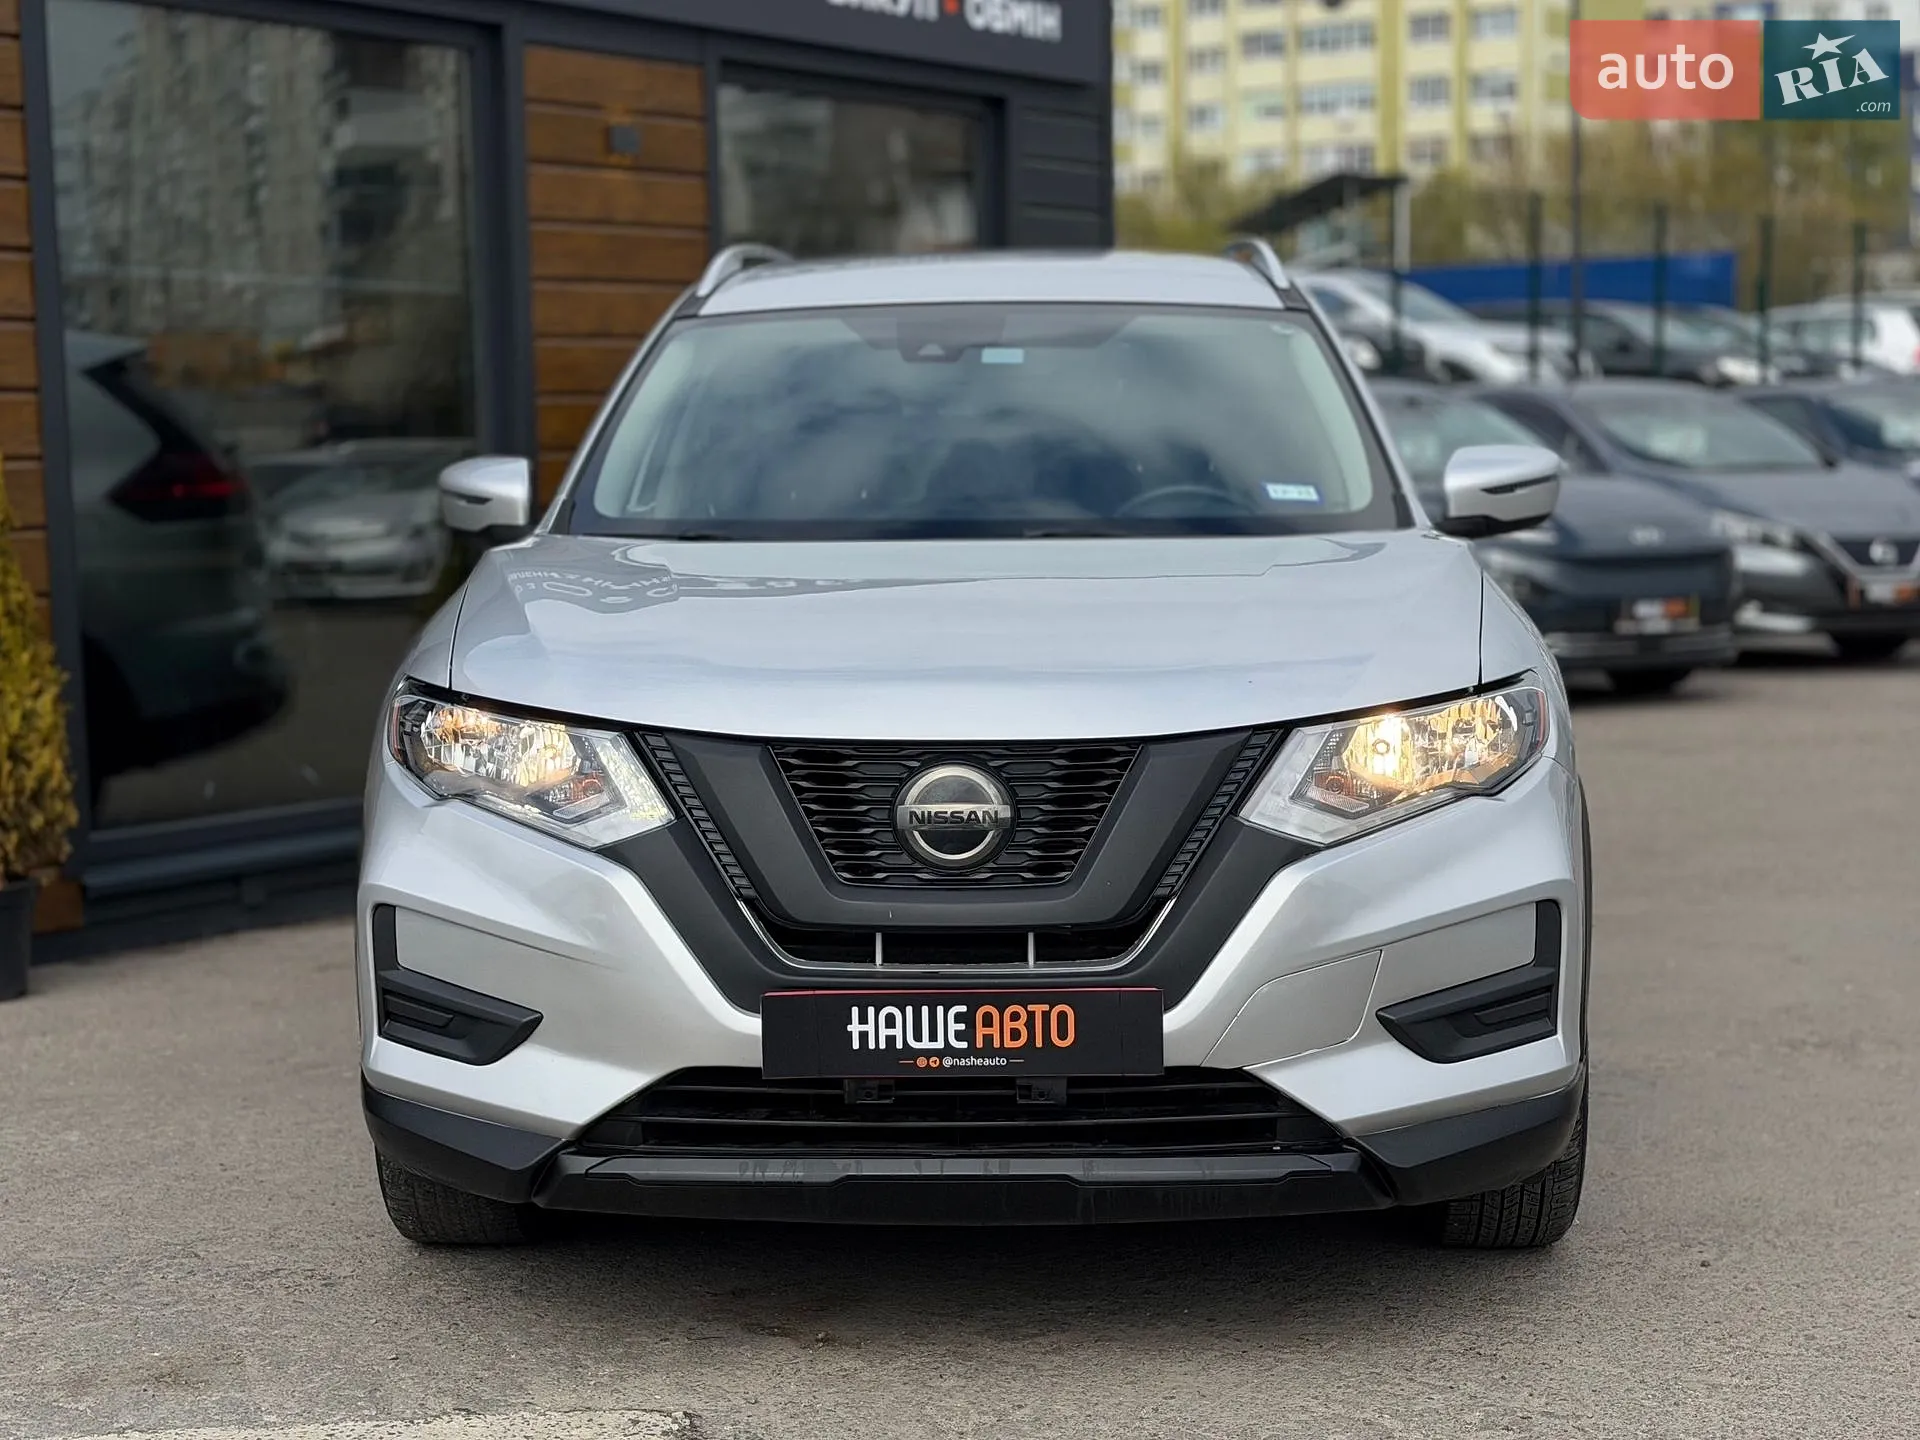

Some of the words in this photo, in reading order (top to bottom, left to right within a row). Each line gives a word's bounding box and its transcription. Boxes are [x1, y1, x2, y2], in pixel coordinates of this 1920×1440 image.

[908, 810, 999, 825] NISSAN
[847, 1004, 968, 1050] НАШЕ
[975, 1003, 1076, 1048] АВТО
[942, 1055, 1007, 1068] @nasheauto
